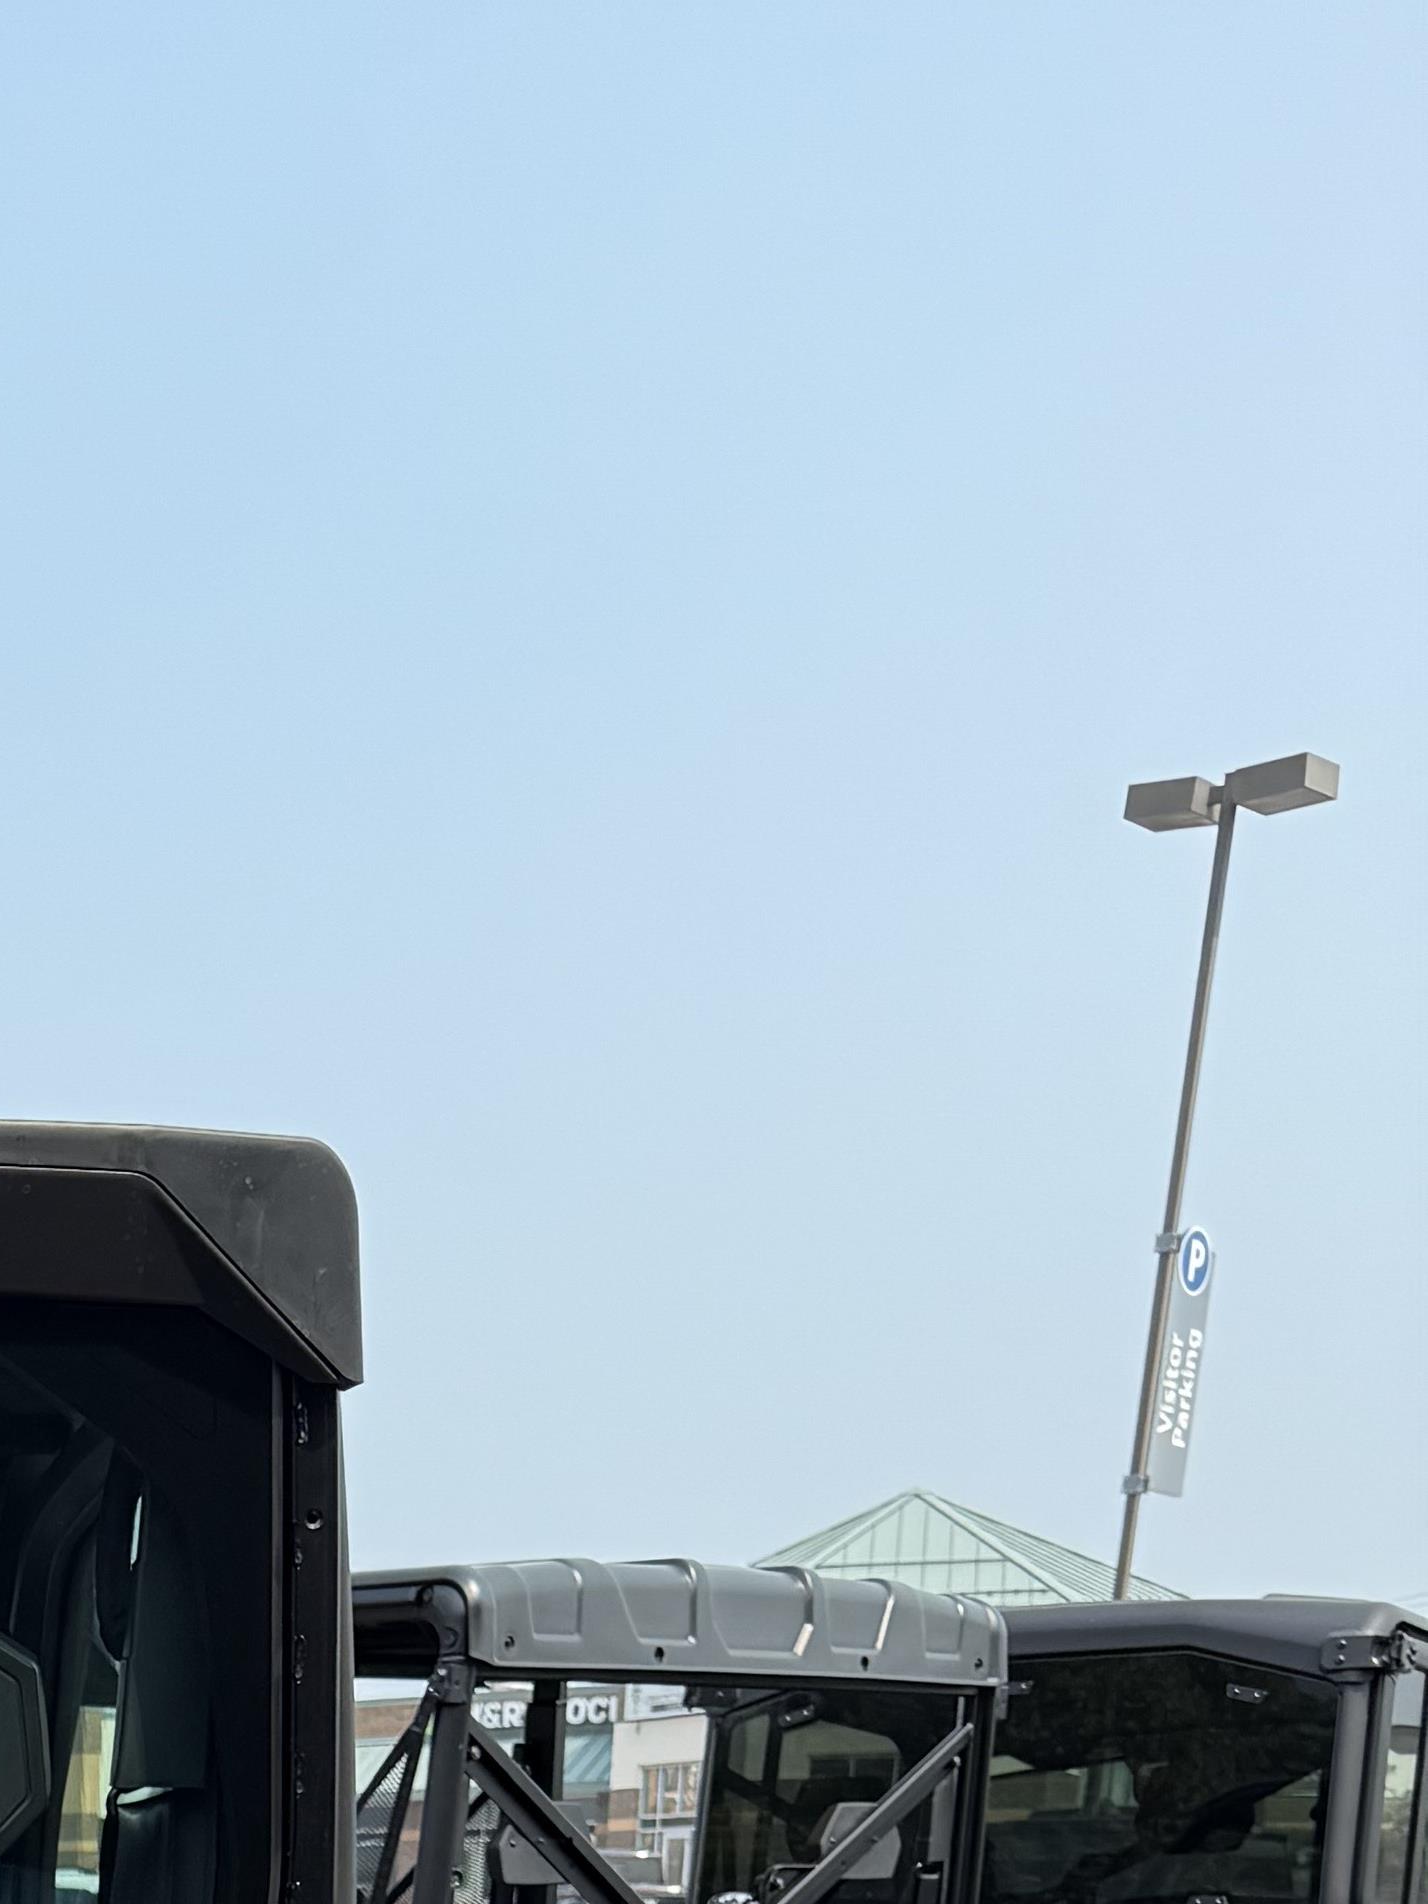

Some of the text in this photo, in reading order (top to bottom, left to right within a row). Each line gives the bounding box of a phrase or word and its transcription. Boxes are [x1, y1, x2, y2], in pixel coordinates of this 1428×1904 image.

[1186, 1238, 1206, 1283] P
[1156, 1331, 1185, 1434] Visitor
[1172, 1327, 1204, 1449] Parking
